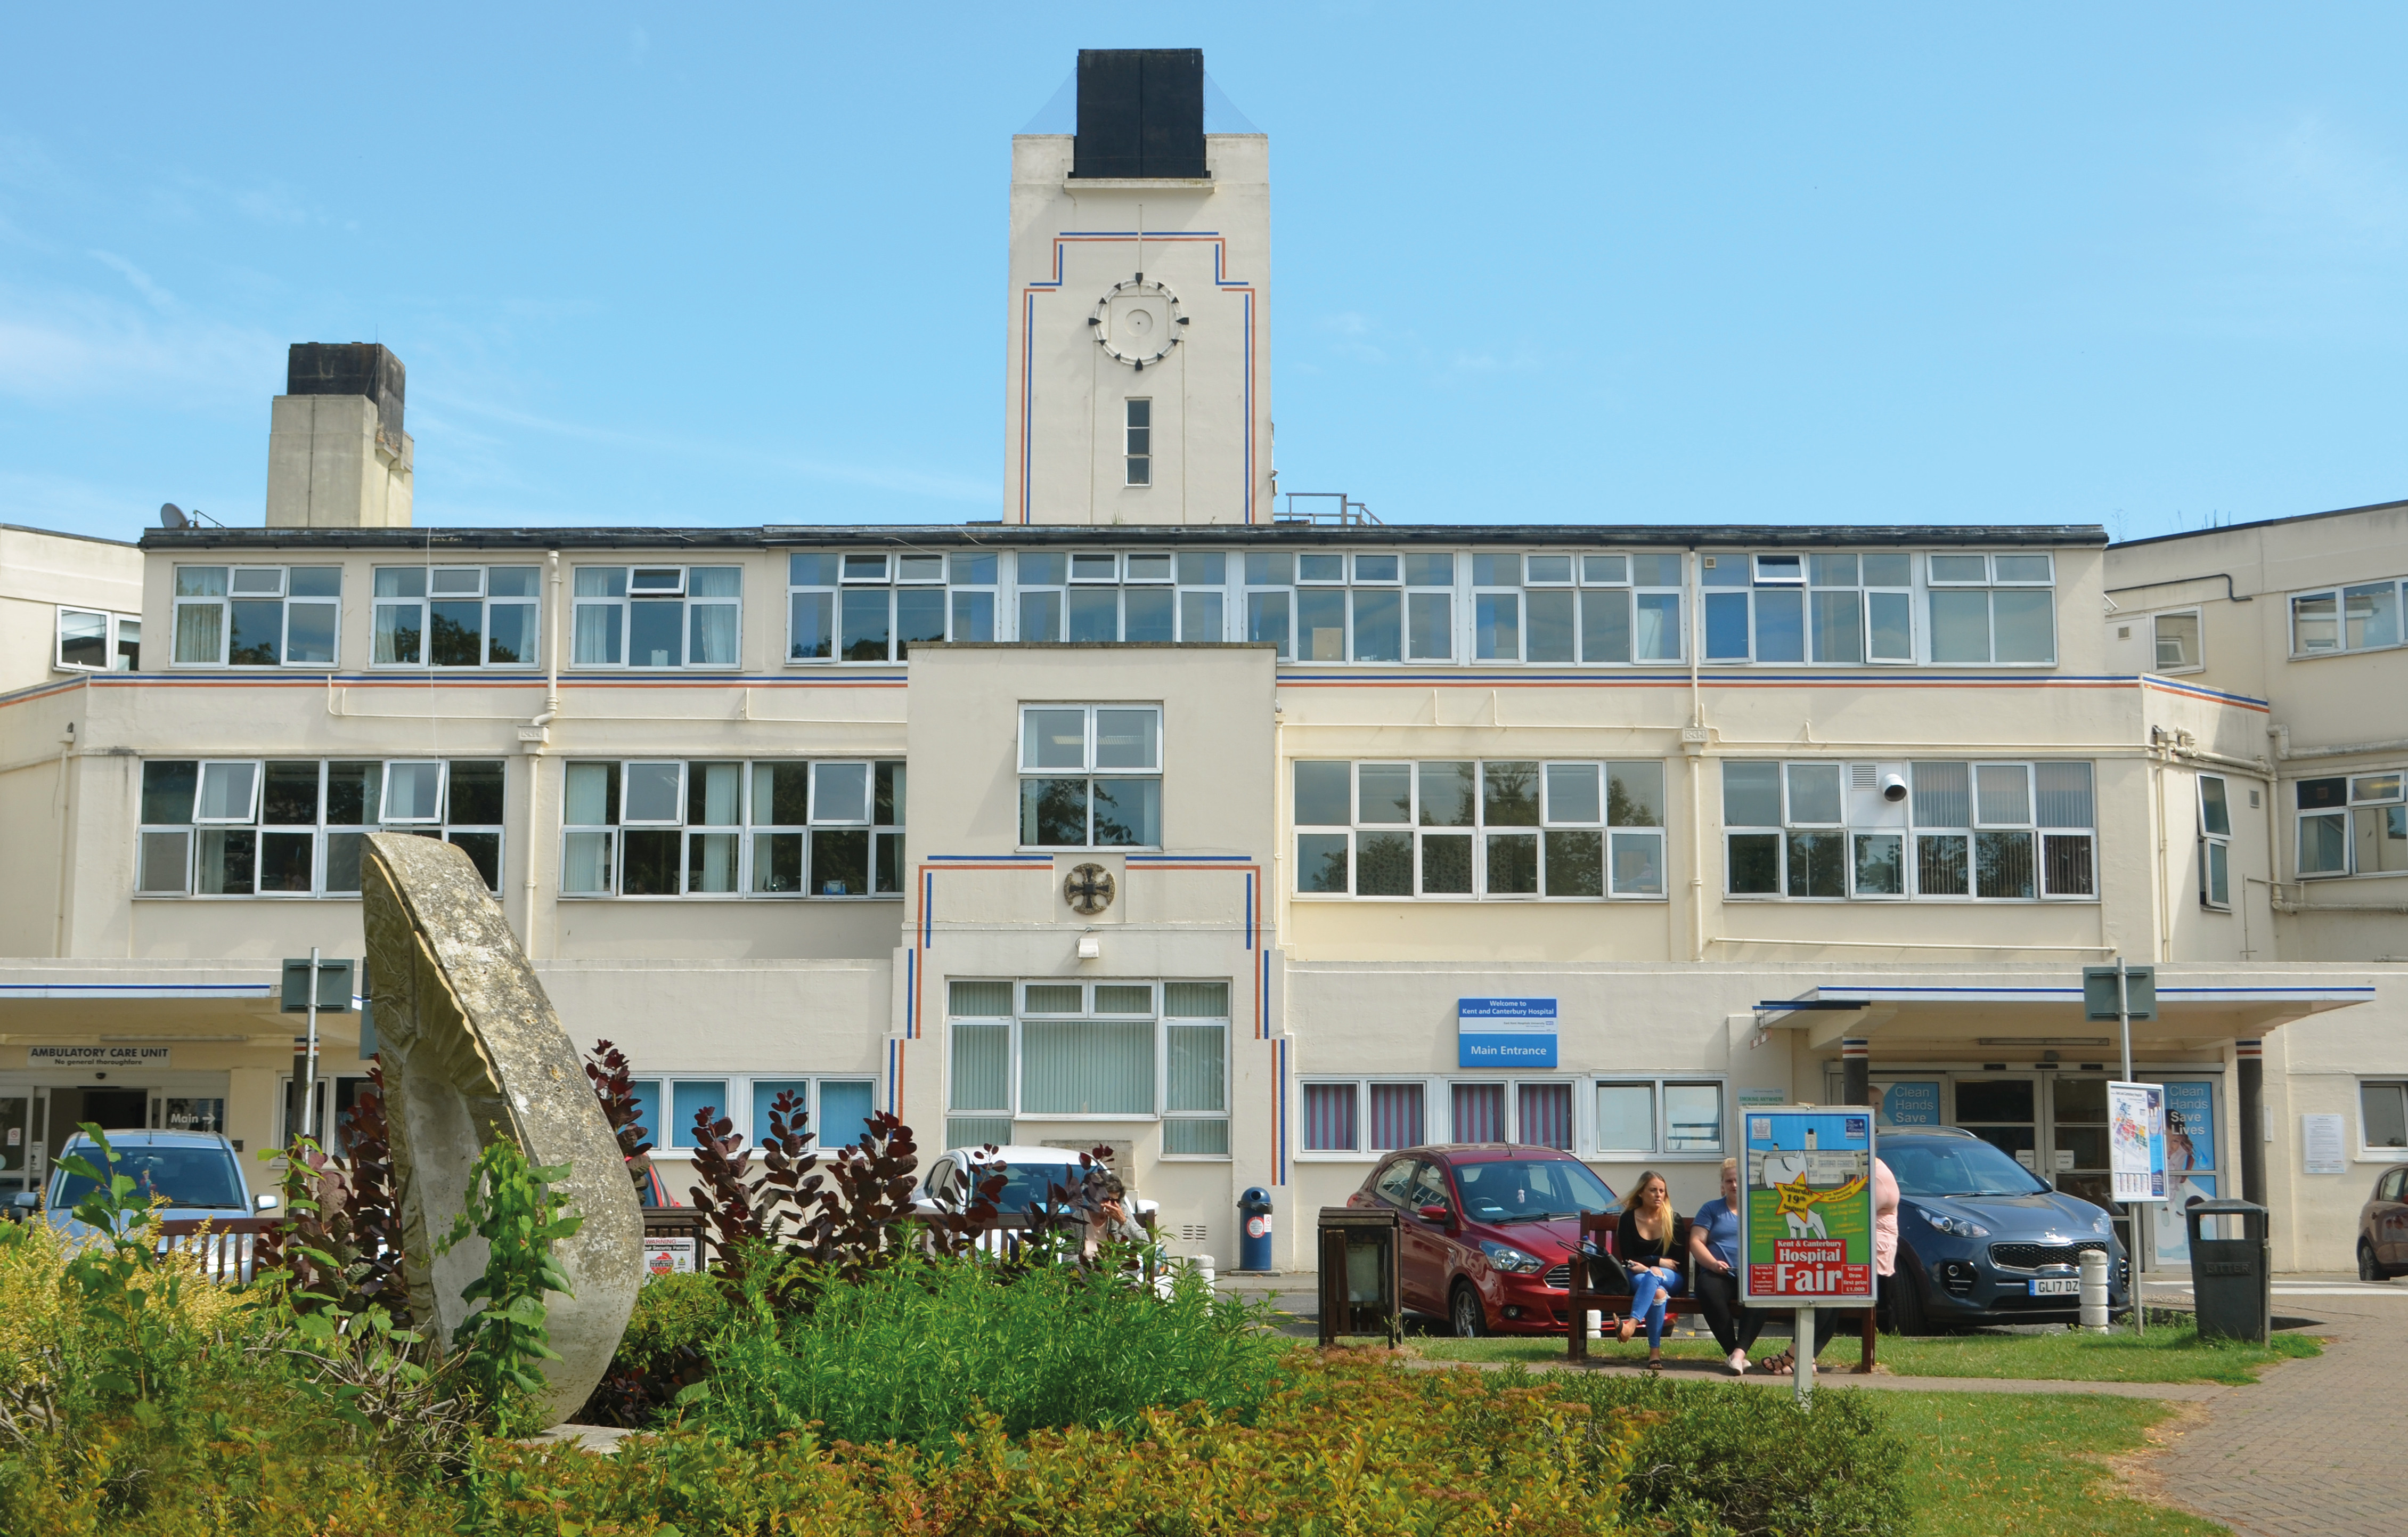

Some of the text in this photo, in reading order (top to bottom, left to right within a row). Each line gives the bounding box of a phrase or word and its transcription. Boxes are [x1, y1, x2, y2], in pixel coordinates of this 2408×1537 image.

[31, 1048, 168, 1057] AMBULATORY CARE UNIT
[1471, 1046, 1547, 1054] Main Entrance
[1896, 1087, 1929, 1097] Clean
[2170, 1086, 2203, 1096] Clean
[1896, 1100, 1933, 1110] Hands
[2170, 1099, 2208, 1109] Hands
[170, 1113, 199, 1123] Main
[1896, 1112, 1926, 1123] Save
[2170, 1111, 2201, 1122] Save
[2172, 1124, 2205, 1135] Lives
[1782, 1185, 1813, 1196] Saturday
[1787, 1194, 1806, 1203] 19th
[1783, 1203, 1805, 1213] August
[1780, 1248, 1841, 1264] Hospital
[2206, 1264, 2250, 1273] LITTER
[1777, 1263, 1842, 1291] Fair
[2039, 1281, 2079, 1292] GL17 DZ
